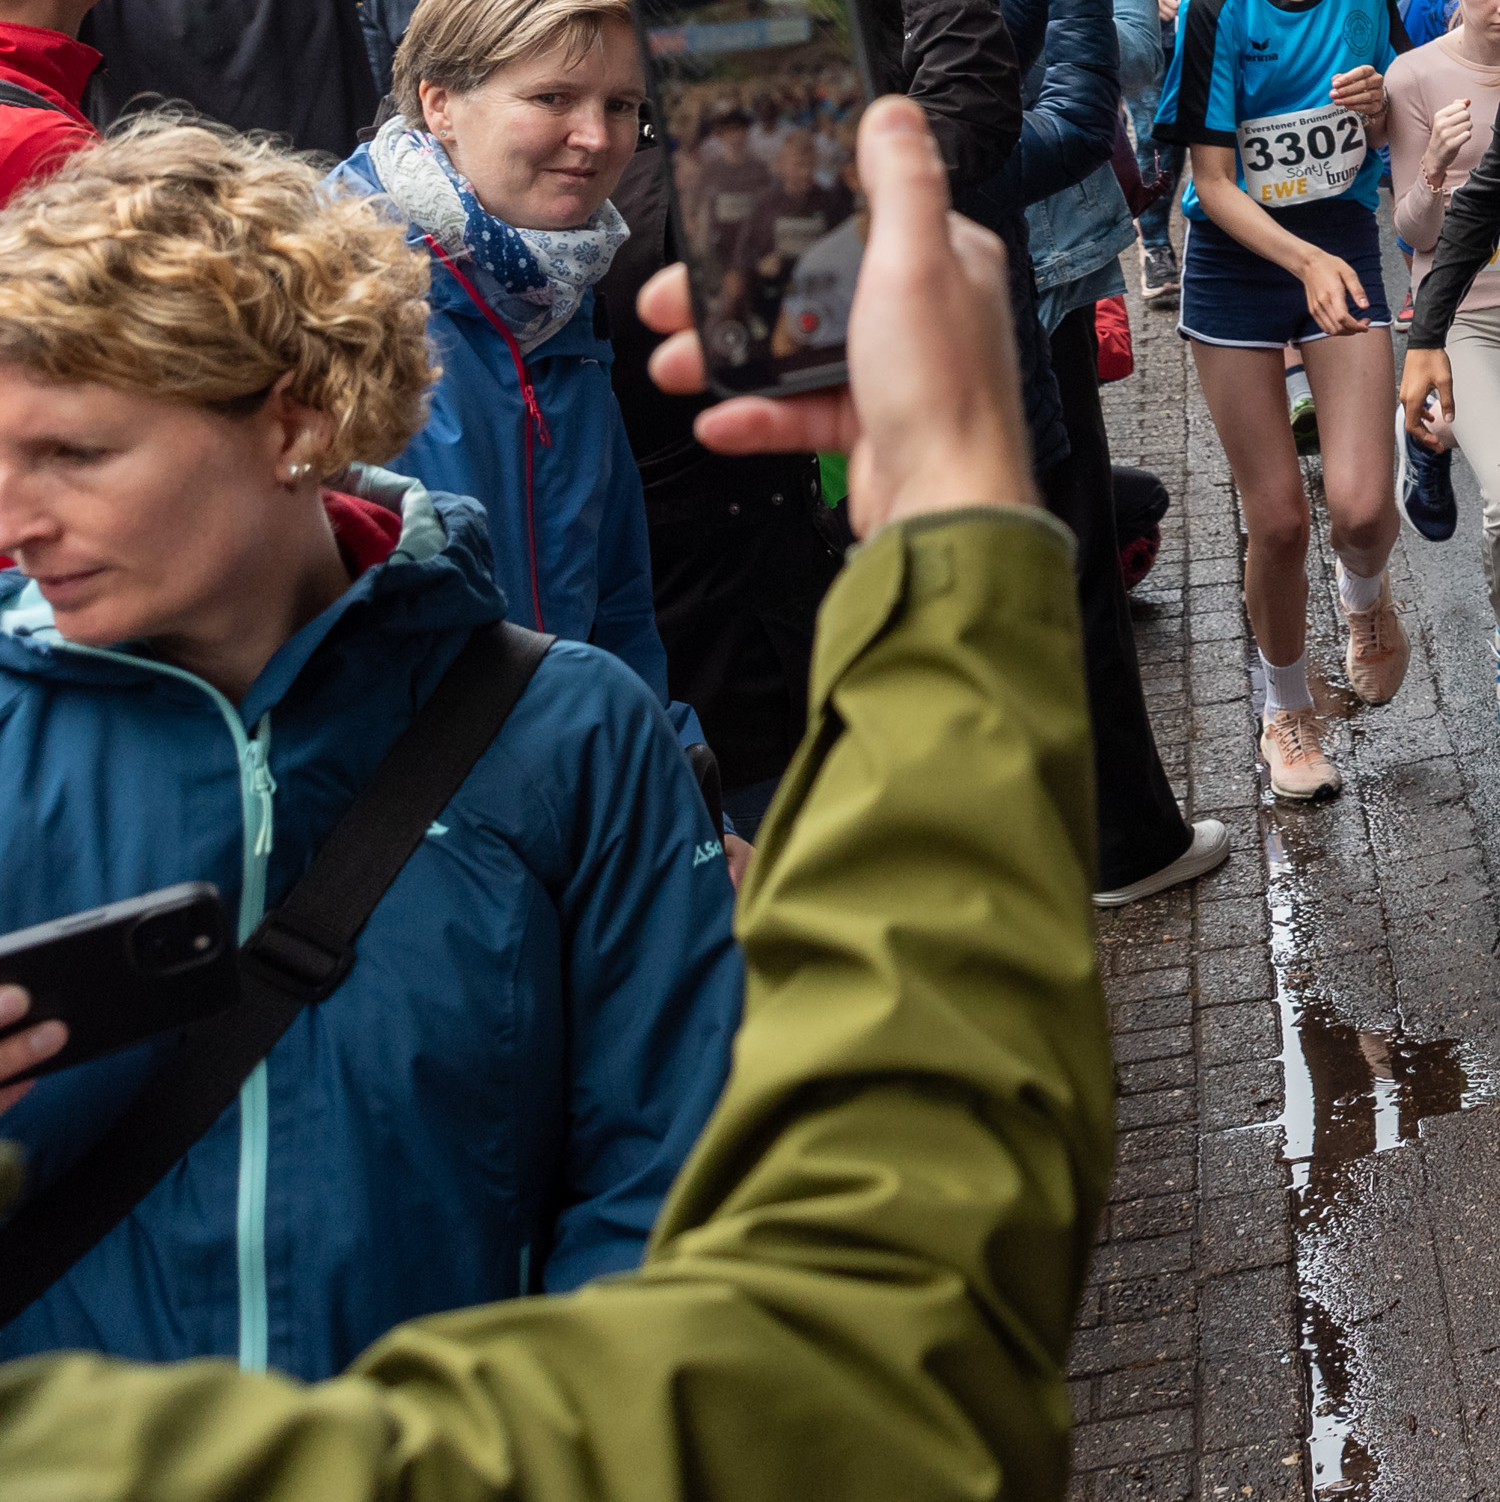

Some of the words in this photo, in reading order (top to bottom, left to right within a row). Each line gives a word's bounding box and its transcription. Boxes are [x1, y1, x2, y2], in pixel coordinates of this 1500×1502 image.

[1245, 52, 1279, 62] erima
[1244, 120, 1297, 135] Everstener
[1299, 107, 1350, 126] Brunnenlau
[1243, 116, 1364, 172] 3302
[1261, 177, 1308, 202] EWE
